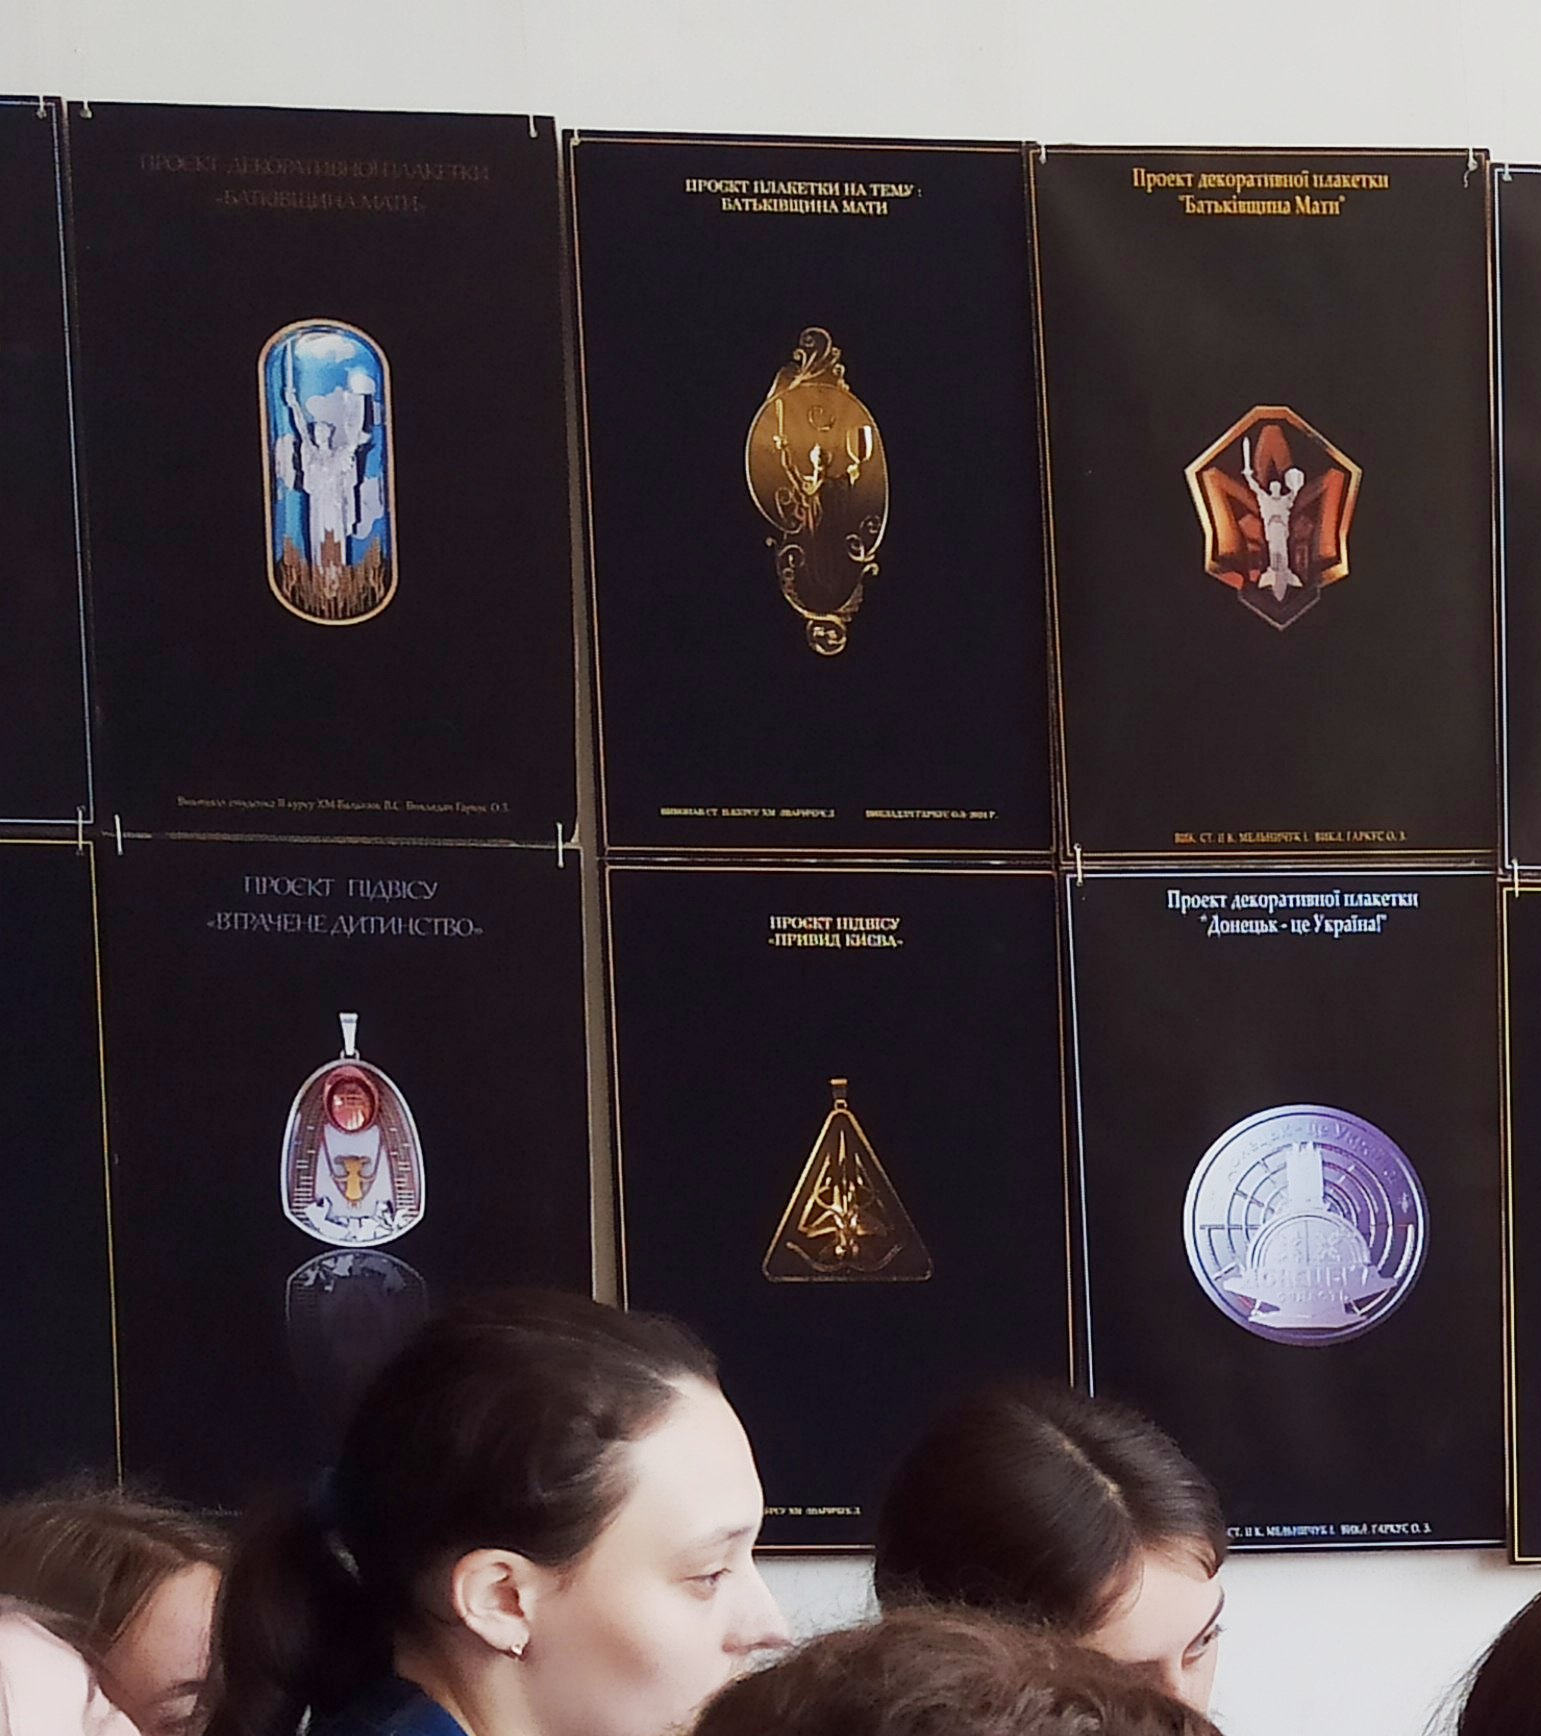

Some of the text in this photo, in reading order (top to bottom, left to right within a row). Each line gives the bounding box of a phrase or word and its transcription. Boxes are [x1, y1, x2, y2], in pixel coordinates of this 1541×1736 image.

[753, 179, 840, 197] ПЛАКЕТКИ
[844, 182, 867, 197] НА
[1197, 170, 1310, 194] декоративної
[1312, 173, 1390, 190] плакетки
[721, 197, 889, 216] БАТЬКІВЩИНА МАТИ
[349, 878, 438, 904] ПІДВІСУ
[1230, 889, 1340, 914] декоративної
[1343, 892, 1419, 909] плакетки
[836, 916, 901, 931] ПІДВІСУ
[1290, 916, 1310, 936] це
